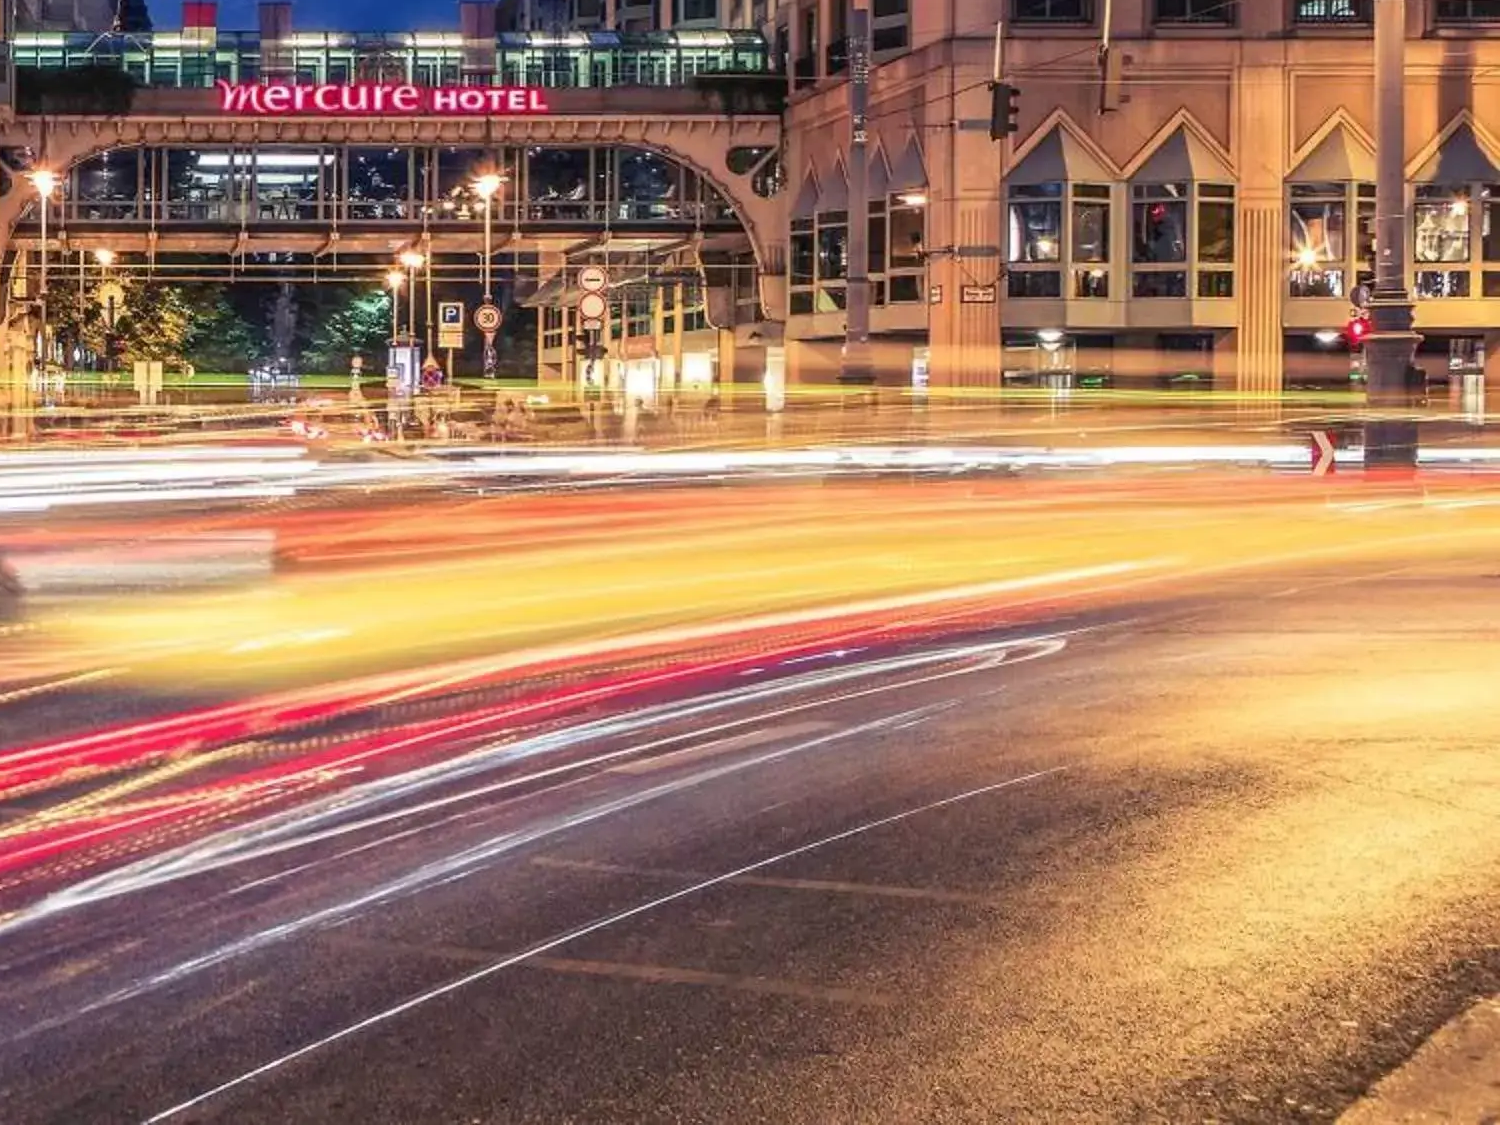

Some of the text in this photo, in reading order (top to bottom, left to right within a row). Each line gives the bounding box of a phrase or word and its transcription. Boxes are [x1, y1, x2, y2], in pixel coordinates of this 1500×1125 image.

[433, 89, 548, 110] HOTEL
[445, 307, 457, 322] P
[482, 313, 494, 324] 30
